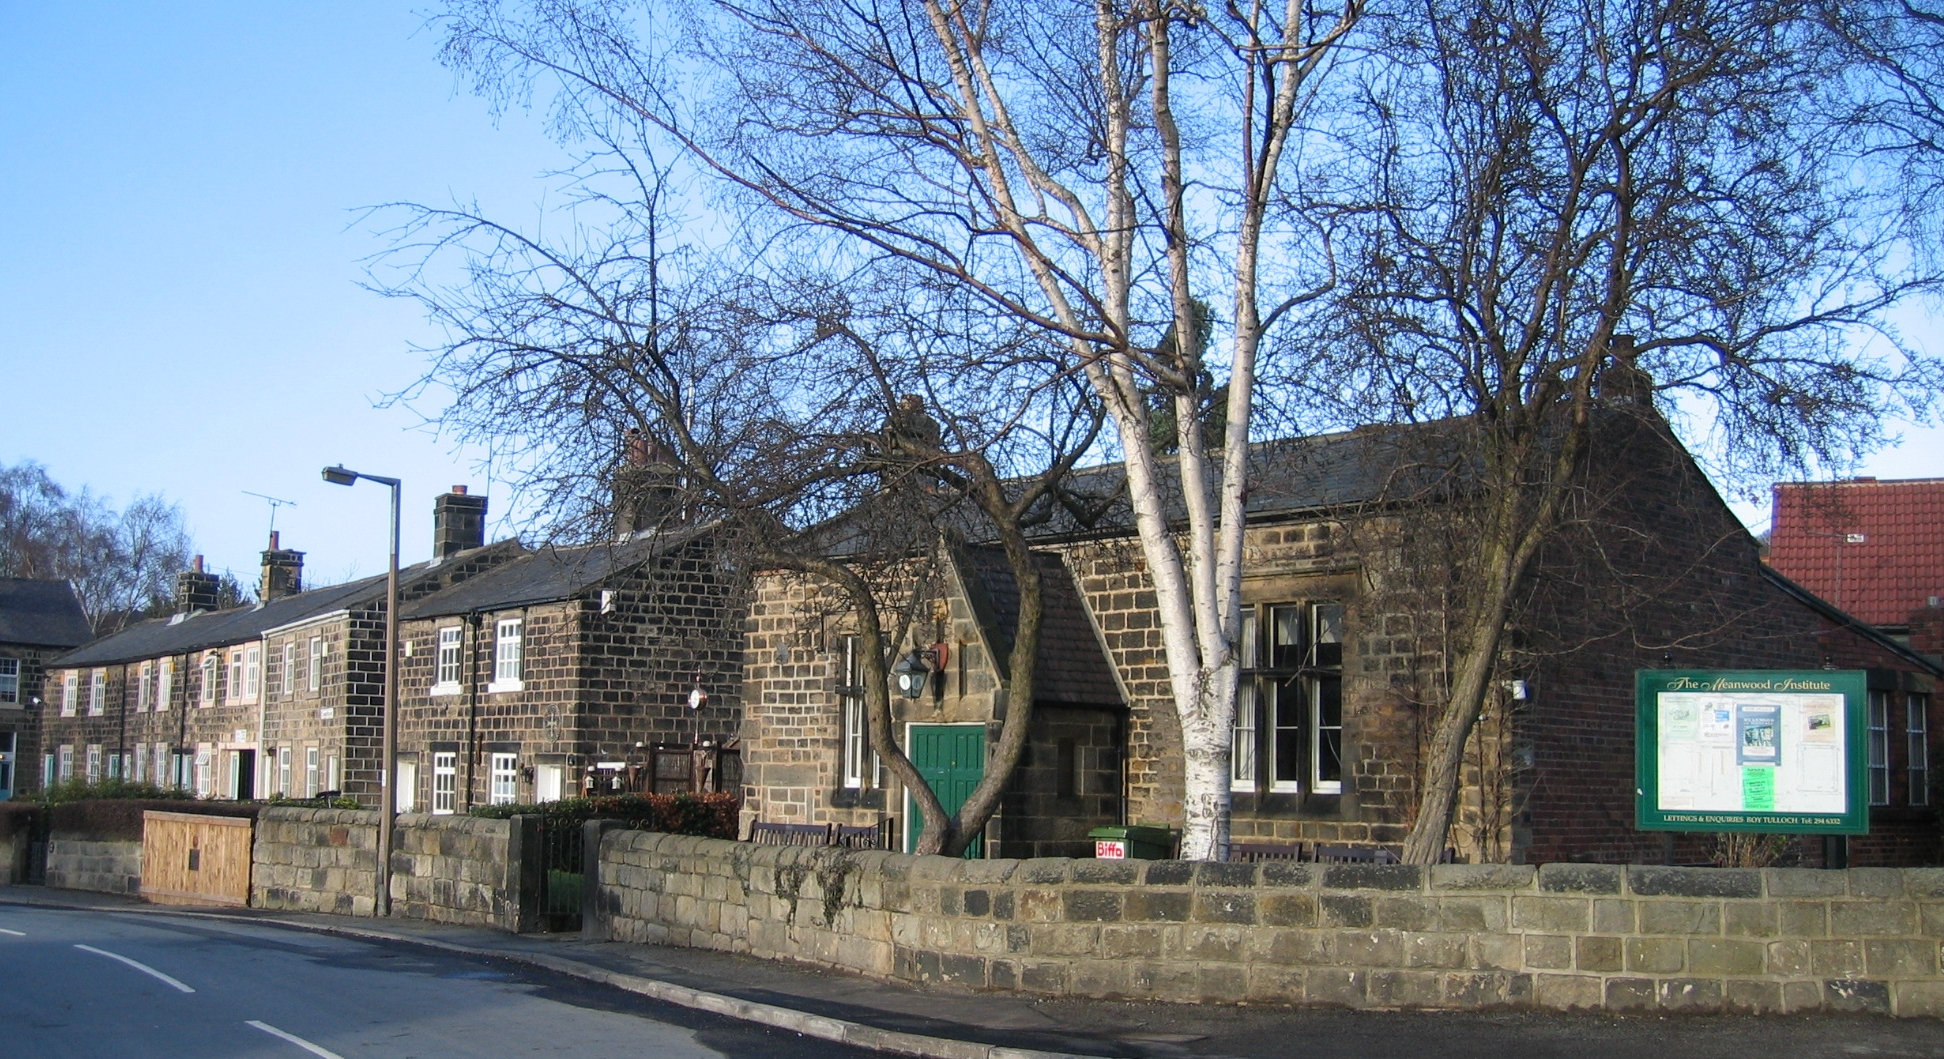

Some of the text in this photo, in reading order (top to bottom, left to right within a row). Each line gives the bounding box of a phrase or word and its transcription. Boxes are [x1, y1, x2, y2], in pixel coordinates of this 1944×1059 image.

[1667, 677, 1831, 691] The Meanwood Institute
[1098, 842, 1122, 857] Biffa
